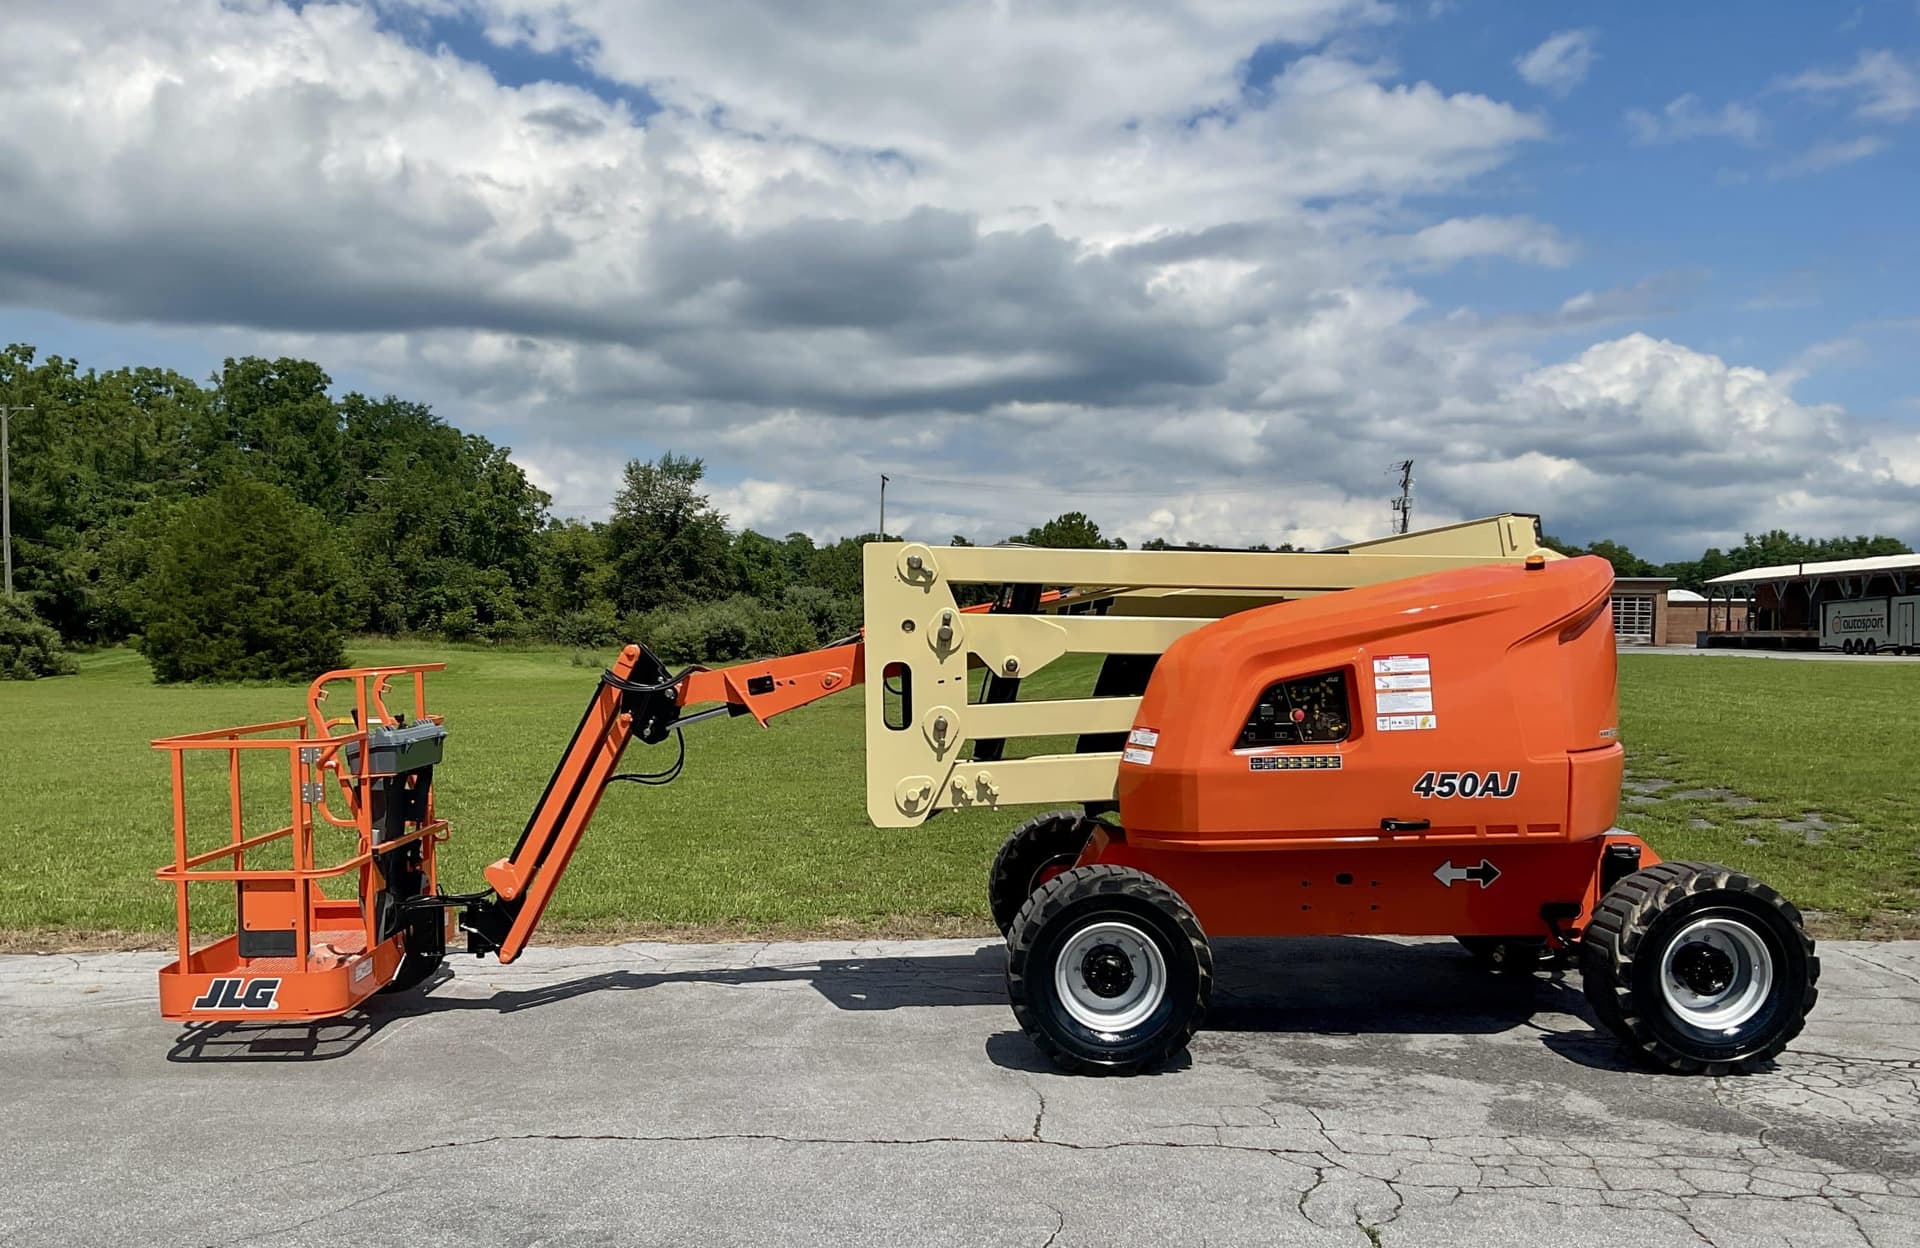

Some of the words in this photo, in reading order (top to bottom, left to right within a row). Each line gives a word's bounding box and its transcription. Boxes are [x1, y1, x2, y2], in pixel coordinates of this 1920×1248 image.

[1843, 617, 1884, 632] autosport
[1413, 772, 1519, 798] 450AJ
[193, 979, 281, 1009] JLG
